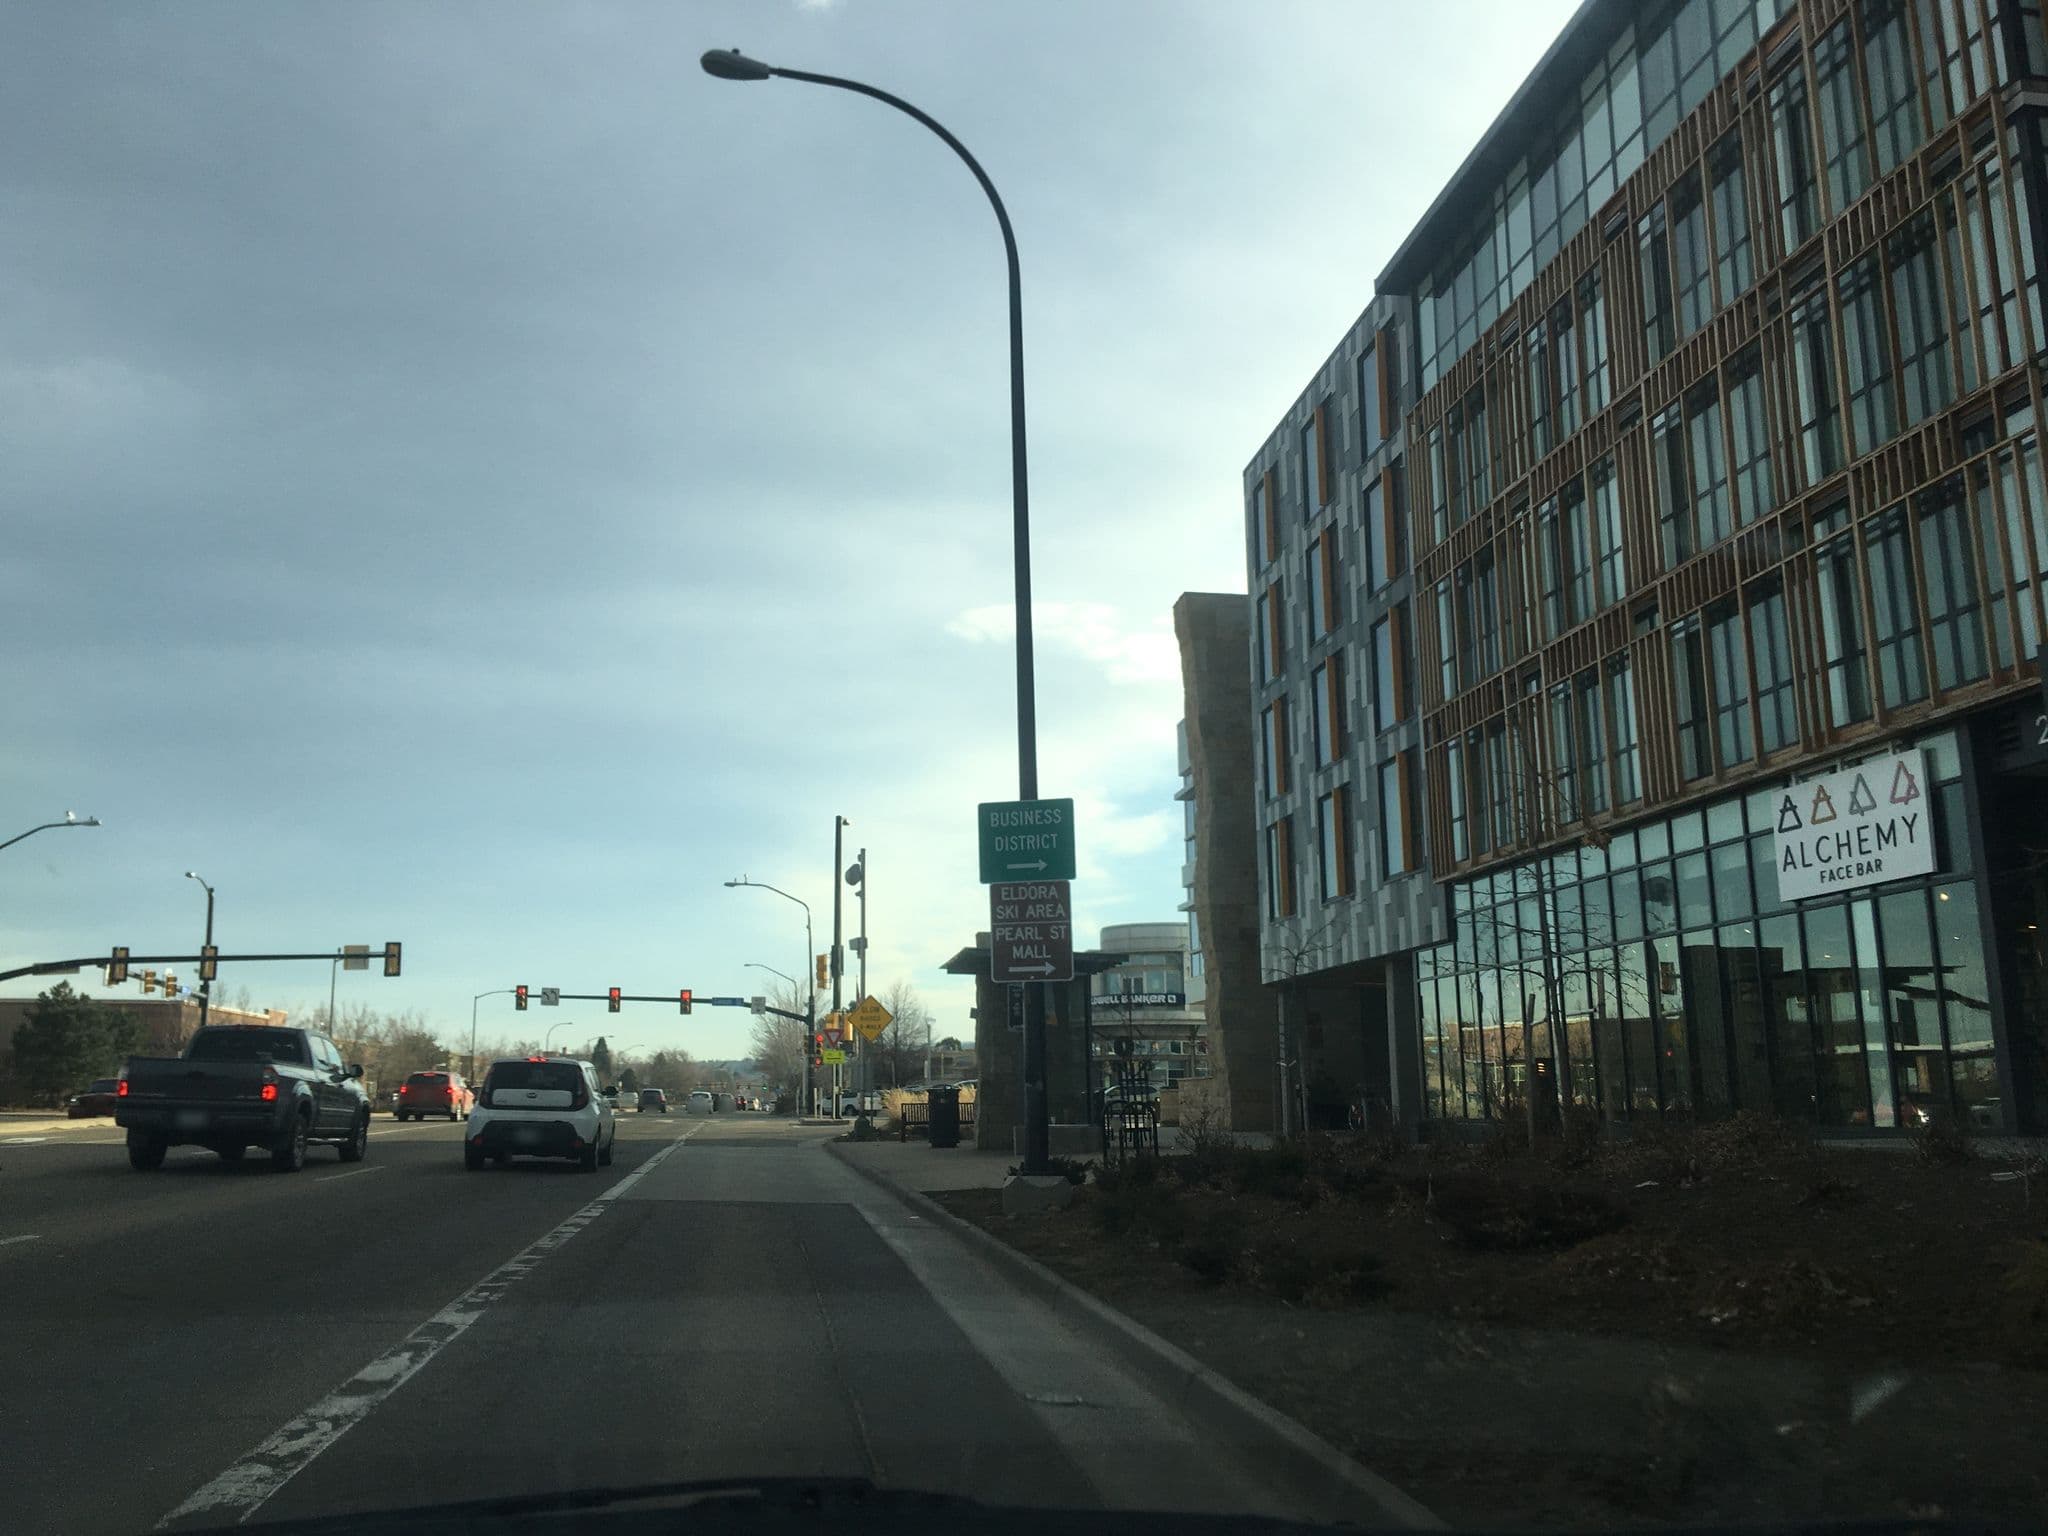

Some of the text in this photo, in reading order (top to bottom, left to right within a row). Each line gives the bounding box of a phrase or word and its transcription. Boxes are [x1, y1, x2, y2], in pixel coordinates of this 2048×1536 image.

[990, 808, 1062, 827] BUSINESS
[995, 833, 1058, 851] DISTRICT
[1783, 813, 1917, 872] ALCHEMY
[1820, 858, 1883, 883] FACE BAR
[1002, 885, 1058, 900] ELDORA
[996, 903, 1065, 919] SKI AREA
[995, 925, 1066, 941] PEARL ST
[1012, 944, 1051, 958] MALL
